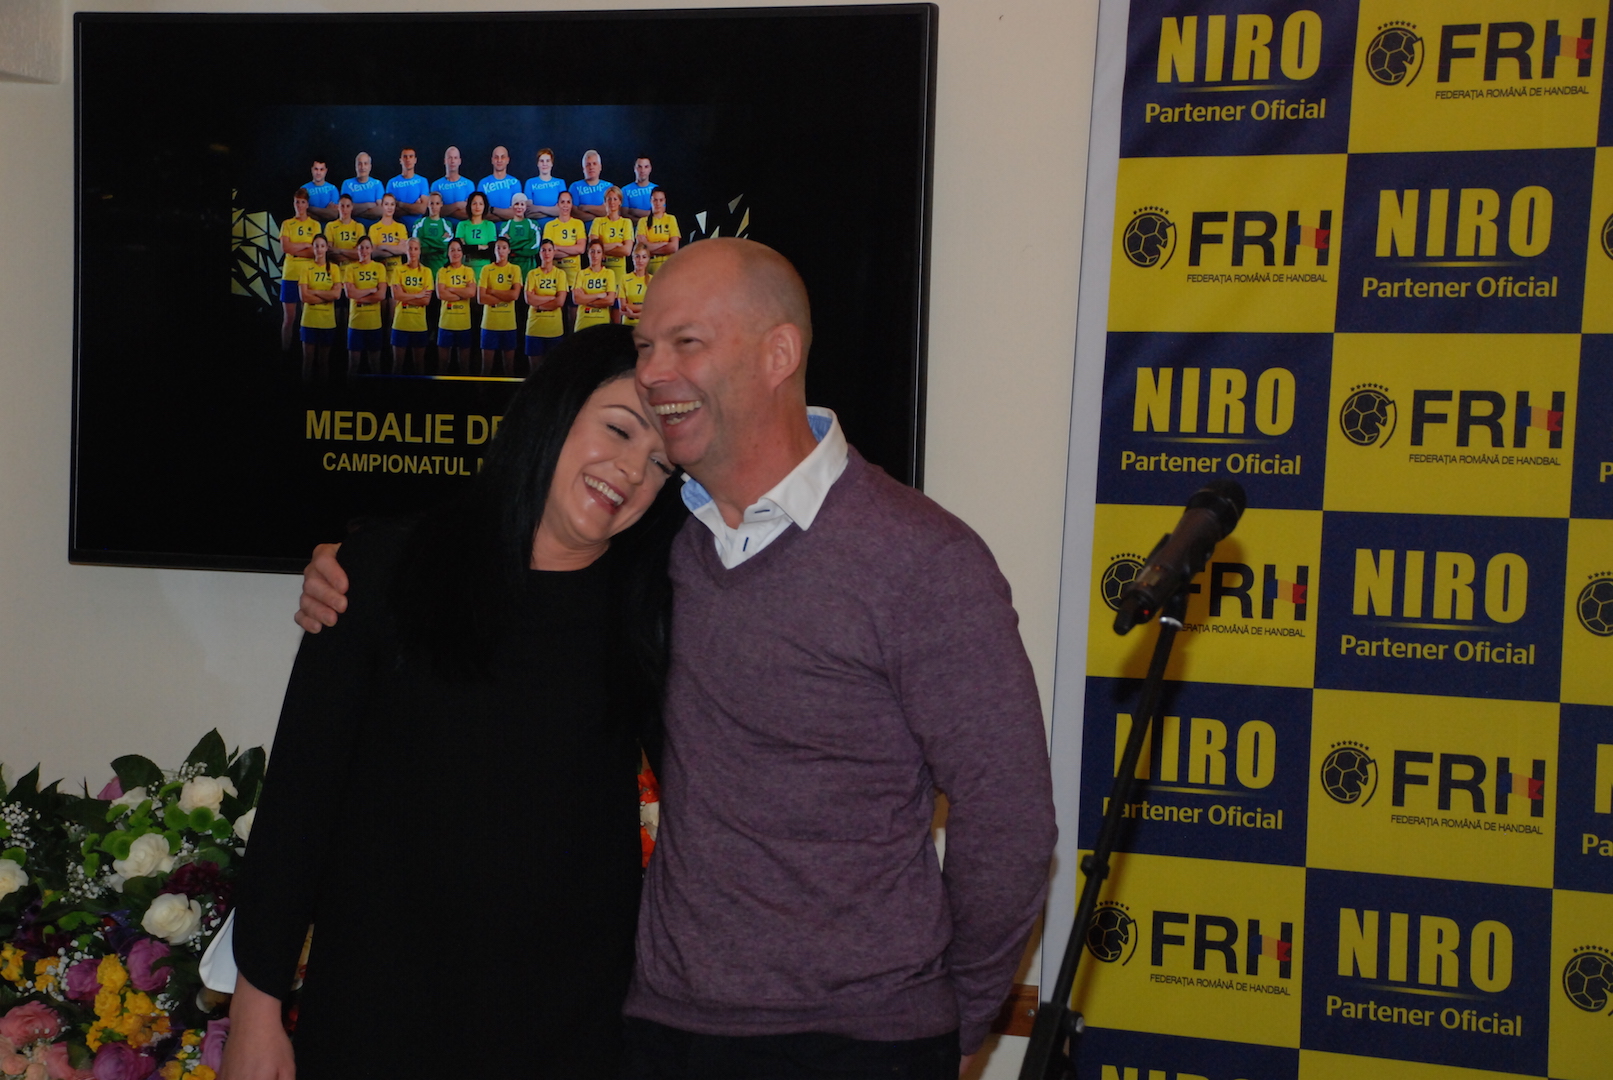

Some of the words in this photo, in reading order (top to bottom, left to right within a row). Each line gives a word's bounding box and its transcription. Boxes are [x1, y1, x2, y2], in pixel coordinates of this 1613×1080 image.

[1157, 10, 1323, 83] NIRO
[1437, 18, 1597, 83] FRH
[1529, 87, 1542, 97] DE
[1543, 86, 1589, 95] HANDBAL
[1145, 101, 1245, 123] Partener
[1250, 98, 1326, 121] Oficial
[1375, 185, 1554, 258] NIRO
[298, 226, 304, 236] 6
[340, 231, 350, 241] 13
[471, 229, 482, 239] 12
[561, 229, 568, 239] 9
[609, 228, 615, 238] 3
[653, 225, 662, 234] 11
[381, 233, 394, 243] 36
[1188, 209, 1333, 267] FRH
[314, 272, 326, 282] 77
[359, 271, 372, 281] 55
[405, 276, 418, 286] 89
[450, 275, 462, 285] 15
[497, 273, 504, 284] 8
[1272, 274, 1284, 283] DE
[1285, 274, 1327, 283] HANDBAL
[539, 279, 551, 289] 22
[587, 279, 601, 289] 88
[636, 284, 643, 294] 7
[1362, 276, 1471, 298] Partener
[1476, 276, 1558, 298] Oficial
[1133, 367, 1296, 436] NIRO
[1410, 390, 1566, 449] FRH
[305, 409, 455, 444] MEDALIE
[322, 451, 471, 476] CAMPIONATUL
[1121, 451, 1221, 473] Partener
[1226, 453, 1301, 476] Oficial
[1502, 456, 1514, 465] DE
[1516, 456, 1561, 466] HANDBAL
[1353, 548, 1528, 624] NIRO
[1251, 626, 1263, 635] DE
[1264, 627, 1306, 638] HANDBAL
[1340, 634, 1449, 660] Partener
[1453, 640, 1536, 665] Oficial
[1391, 750, 1547, 818] FRH
[1208, 804, 1284, 830] Oficial
[1484, 822, 1496, 831] DE
[1499, 823, 1543, 835] HANDBAL
[1150, 911, 1293, 980] FRH
[1338, 907, 1513, 994] NIRO
[1236, 982, 1248, 992] DE
[1249, 984, 1291, 996] HANDBAL
[1326, 995, 1434, 1029] Partener
[1439, 1005, 1523, 1038] Oficial
